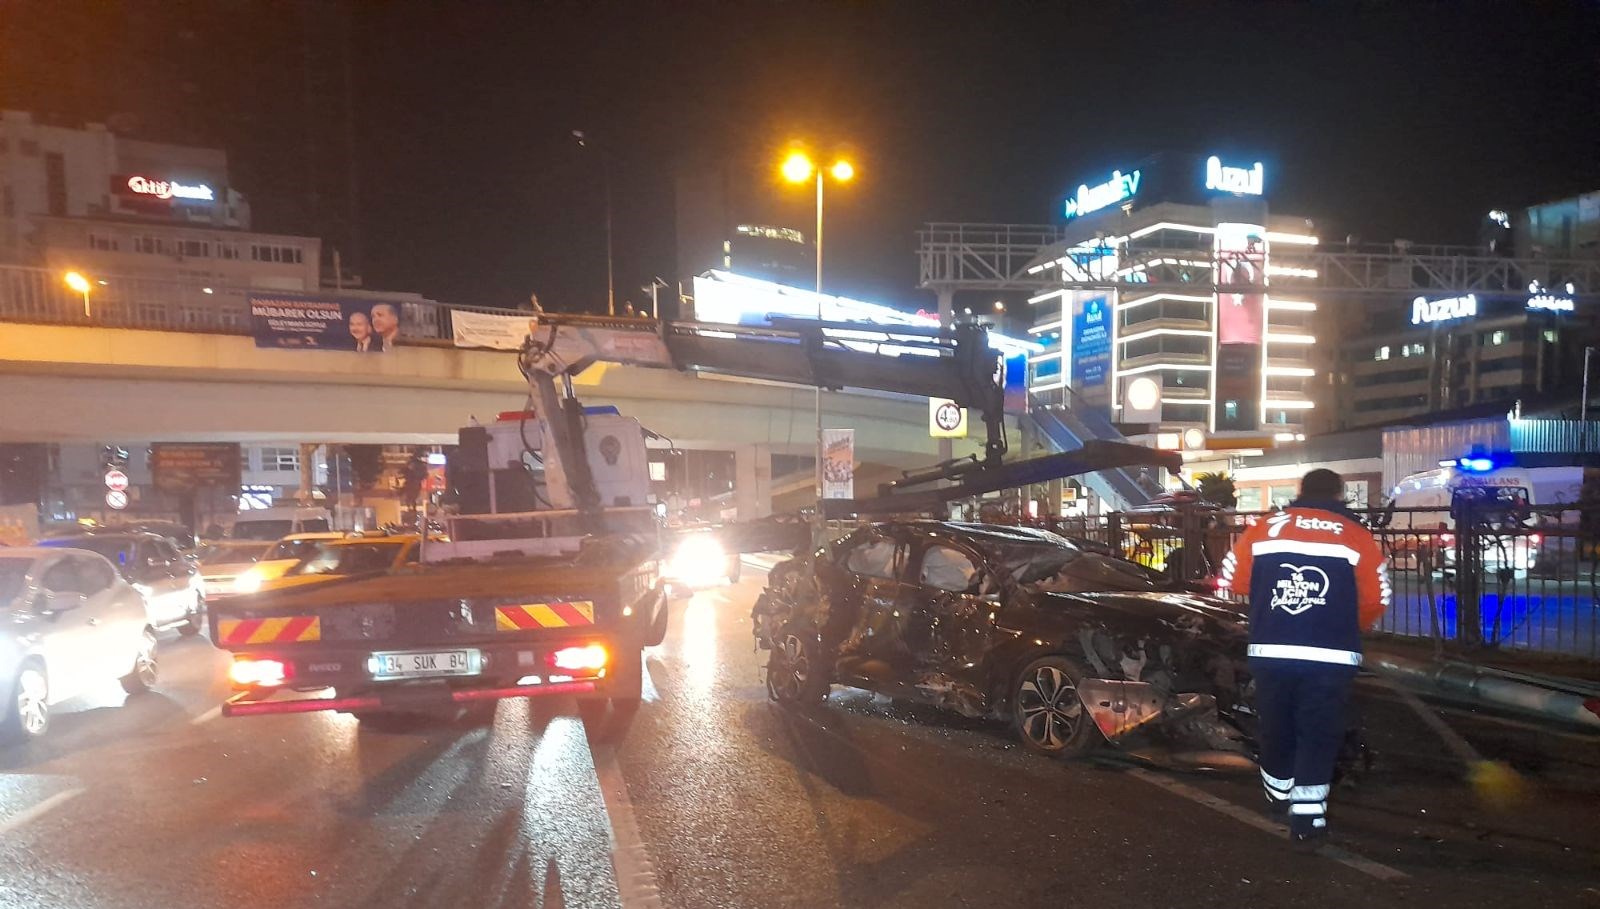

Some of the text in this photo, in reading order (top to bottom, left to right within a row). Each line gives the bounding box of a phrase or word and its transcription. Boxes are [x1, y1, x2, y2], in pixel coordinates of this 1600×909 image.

[305, 309, 343, 320] OLSUN
[1295, 515, 1344, 535] istaç
[387, 658, 402, 672] 34
[450, 654, 465, 668] 84
